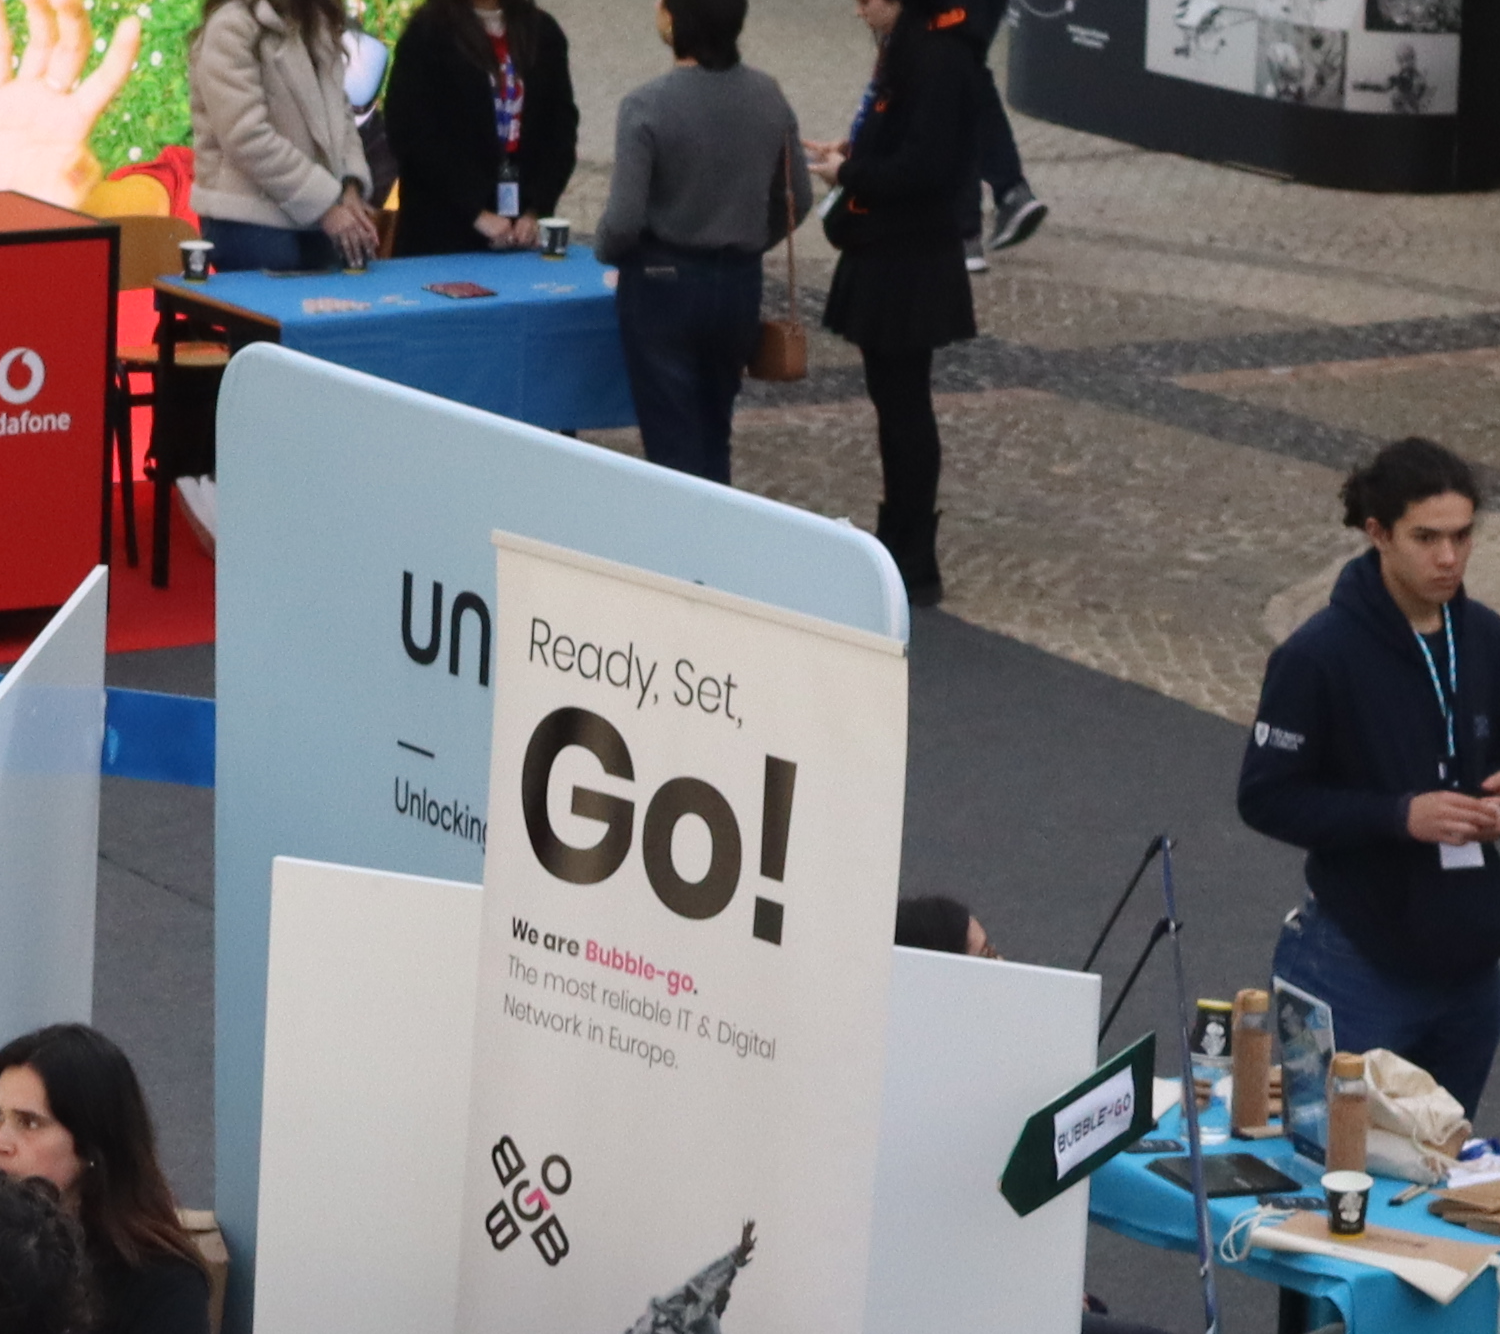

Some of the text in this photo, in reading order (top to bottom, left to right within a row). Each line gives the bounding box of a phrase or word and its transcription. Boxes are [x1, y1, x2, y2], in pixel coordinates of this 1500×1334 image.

[528, 617, 744, 729] Ready, Set,
[521, 705, 798, 947] Go!
[507, 953, 777, 1062] The most reliable IT & Digital
[511, 915, 699, 996] We are Bubble-go.
[503, 992, 680, 1070] Network in Europe.
